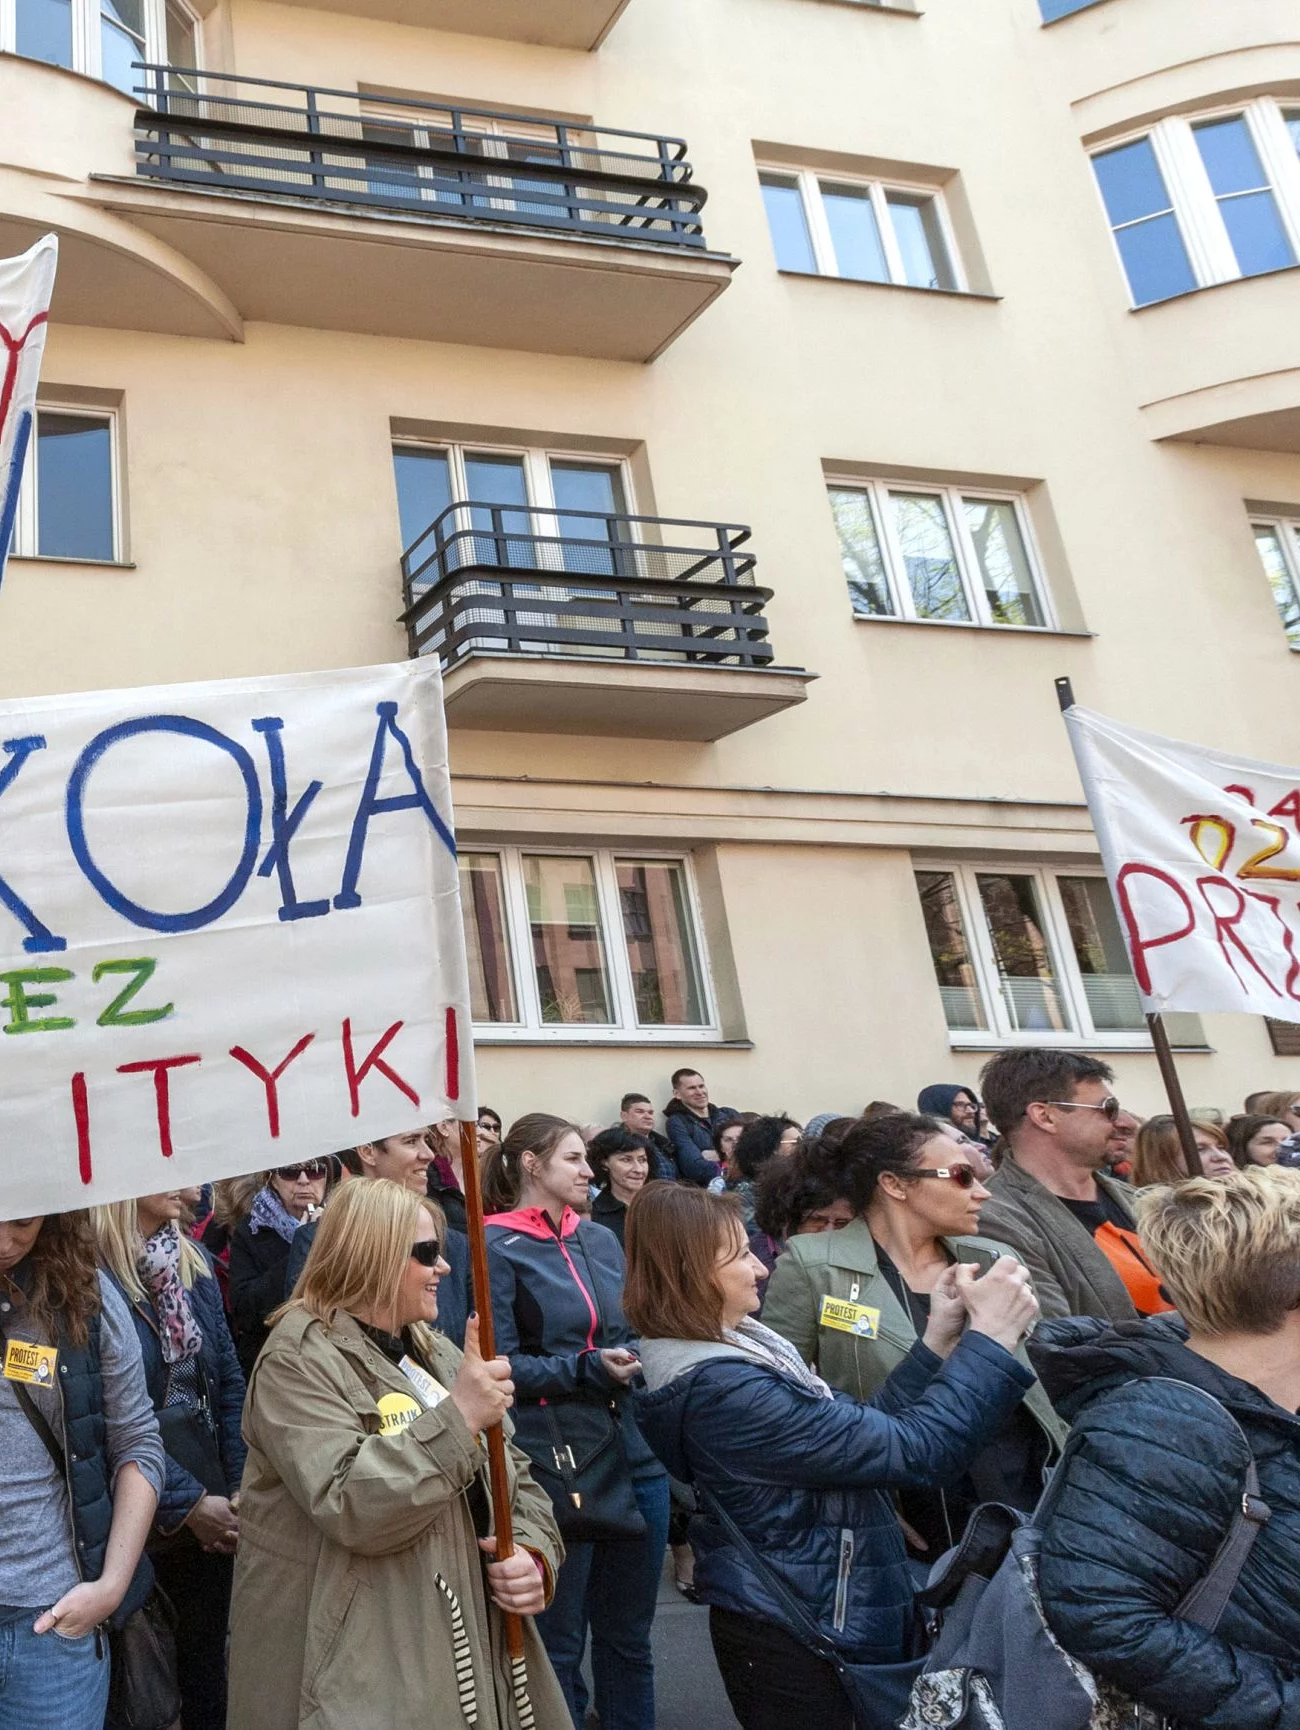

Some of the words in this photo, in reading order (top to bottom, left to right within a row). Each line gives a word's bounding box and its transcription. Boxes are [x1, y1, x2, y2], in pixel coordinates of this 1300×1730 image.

[825, 1302, 858, 1320] PROTEST
[9, 1347, 40, 1366] PROTEST
[380, 1409, 418, 1430] STRAJK
